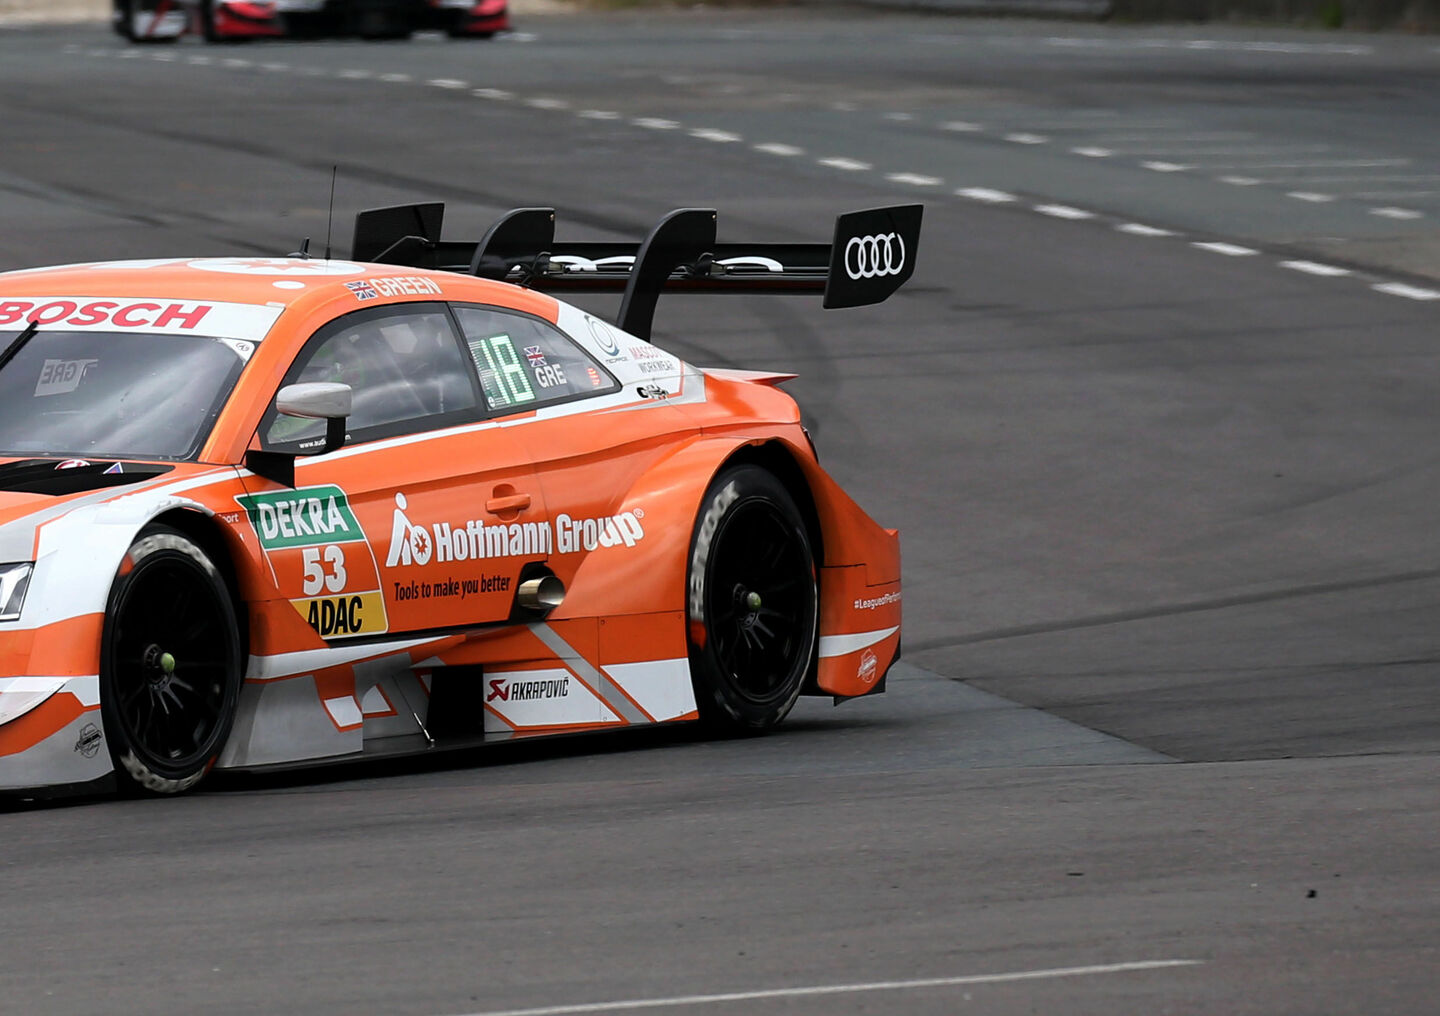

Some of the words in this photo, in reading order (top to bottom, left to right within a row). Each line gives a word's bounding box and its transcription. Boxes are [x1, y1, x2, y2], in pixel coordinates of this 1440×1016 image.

[369, 277, 443, 297] GREEN
[534, 363, 568, 389] GRE
[257, 495, 350, 540] DEKRA
[432, 519, 553, 563] Hoffmann
[301, 544, 348, 596] 53
[393, 580, 419, 601] Tools
[421, 581, 432, 599] to
[433, 577, 460, 598] make
[460, 579, 479, 600] you
[480, 573, 511, 593] better
[307, 595, 363, 636] ADAC
